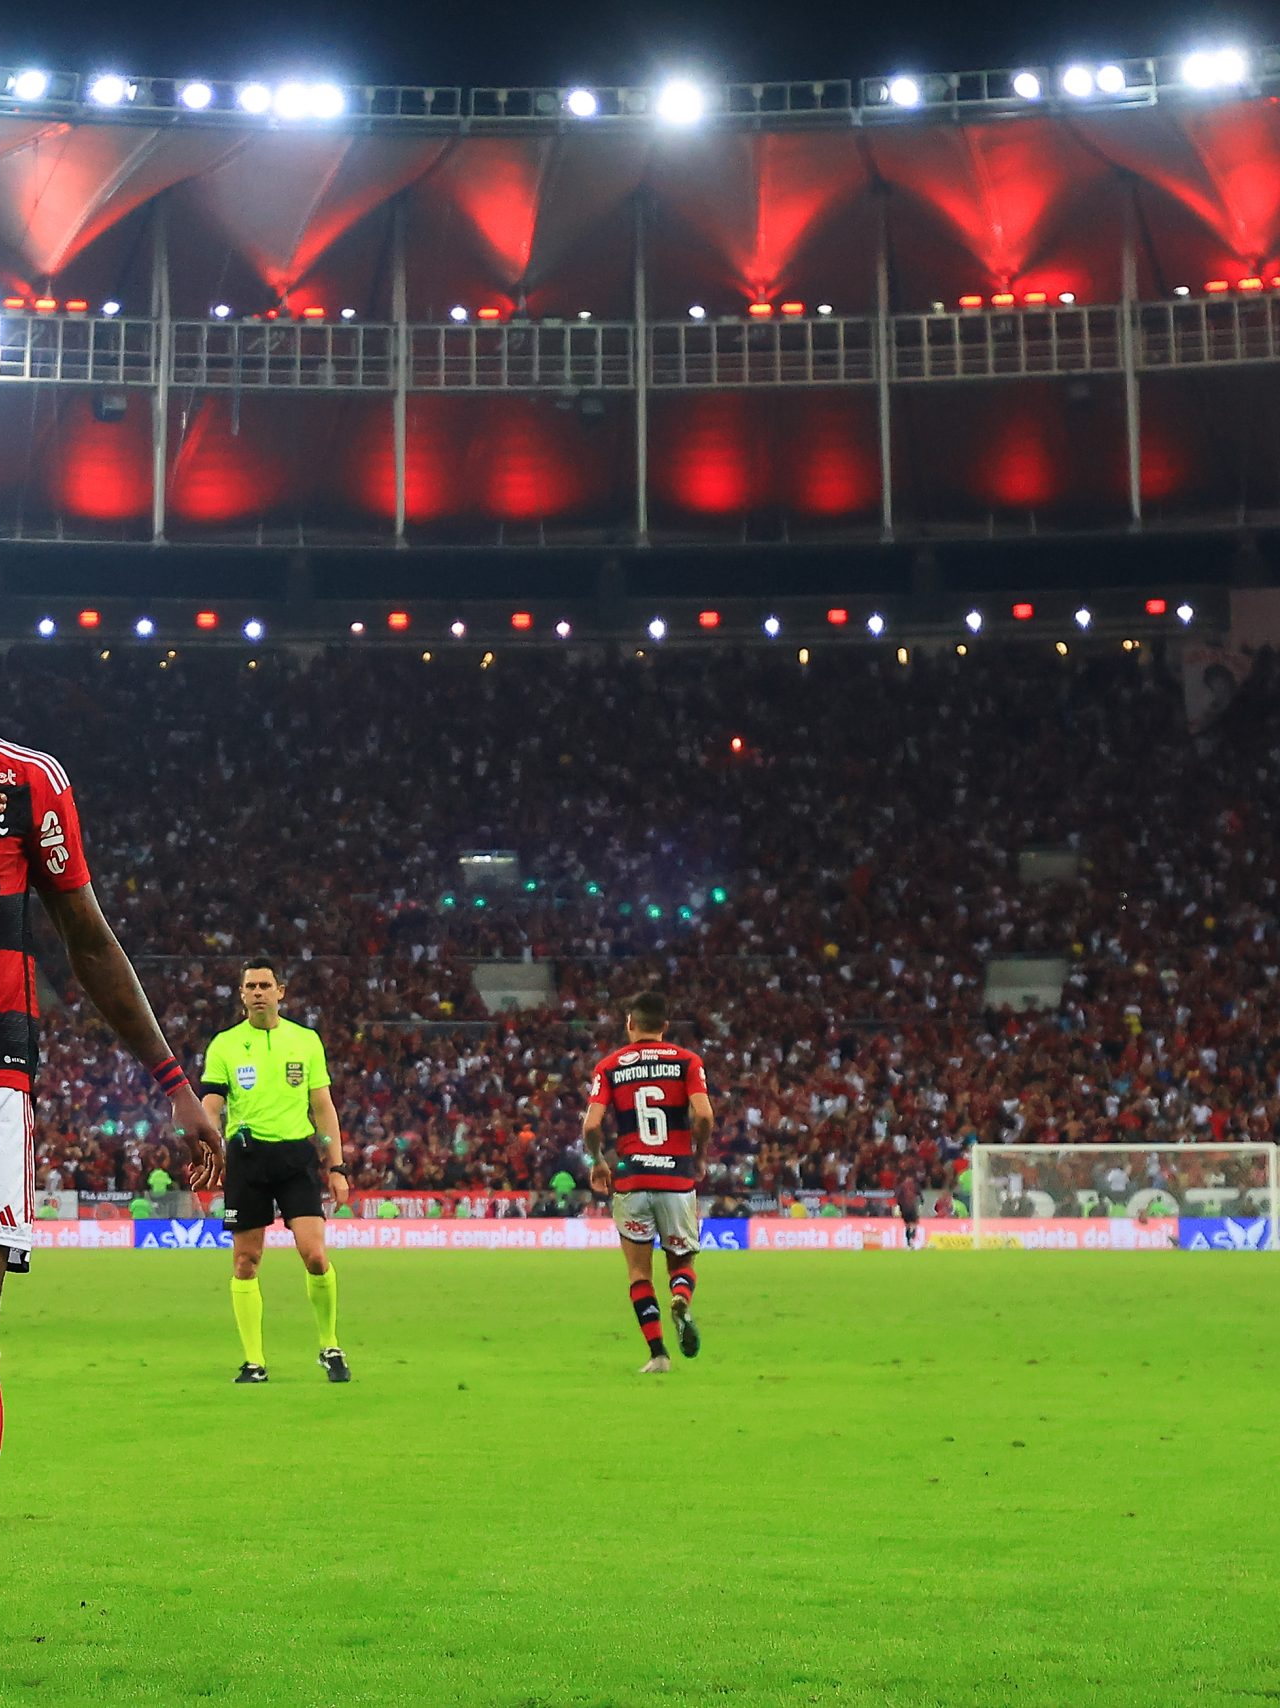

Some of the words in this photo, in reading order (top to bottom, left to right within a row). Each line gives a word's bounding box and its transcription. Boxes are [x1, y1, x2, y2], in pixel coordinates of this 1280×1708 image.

[237, 1066, 255, 1074] FIFA
[614, 1066, 648, 1083] AYRTON
[651, 1064, 681, 1077] LUCAS
[635, 1085, 668, 1146] 6
[405, 1224, 448, 1247] mais
[451, 1226, 536, 1250] completa
[541, 1226, 564, 1247] do
[754, 1227, 770, 1247] A
[775, 1227, 829, 1248] conta
